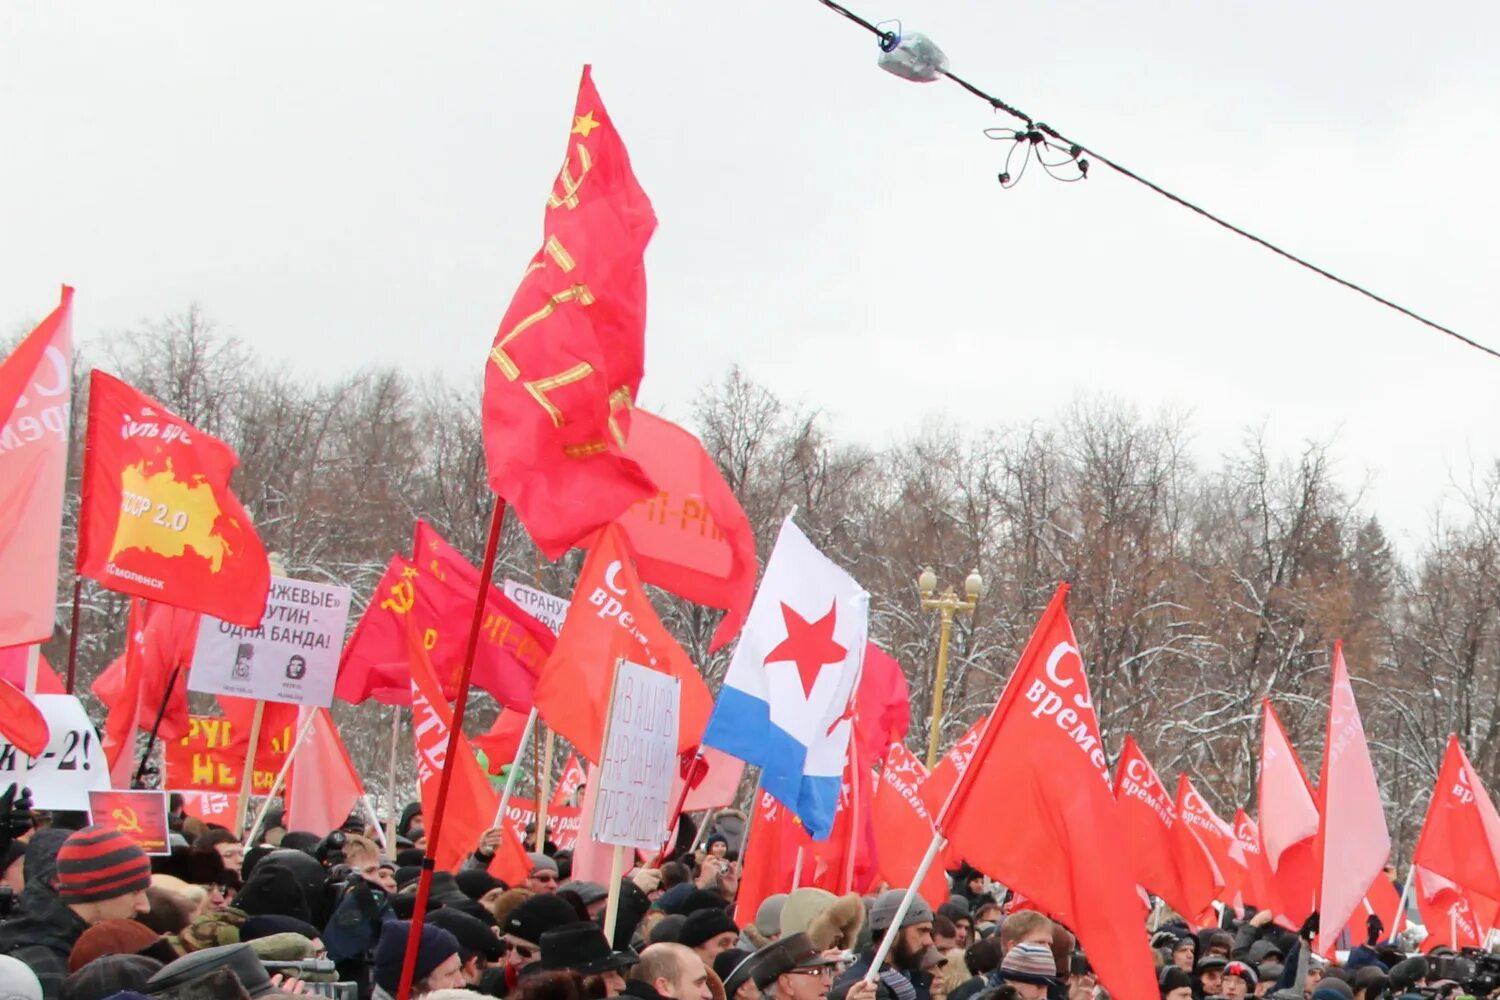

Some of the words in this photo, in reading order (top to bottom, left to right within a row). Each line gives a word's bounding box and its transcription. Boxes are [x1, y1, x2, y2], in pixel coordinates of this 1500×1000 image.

[153, 503, 189, 532] 2.0
[514, 587, 564, 616] СТРАНУ
[270, 626, 332, 649] БАНДА!
